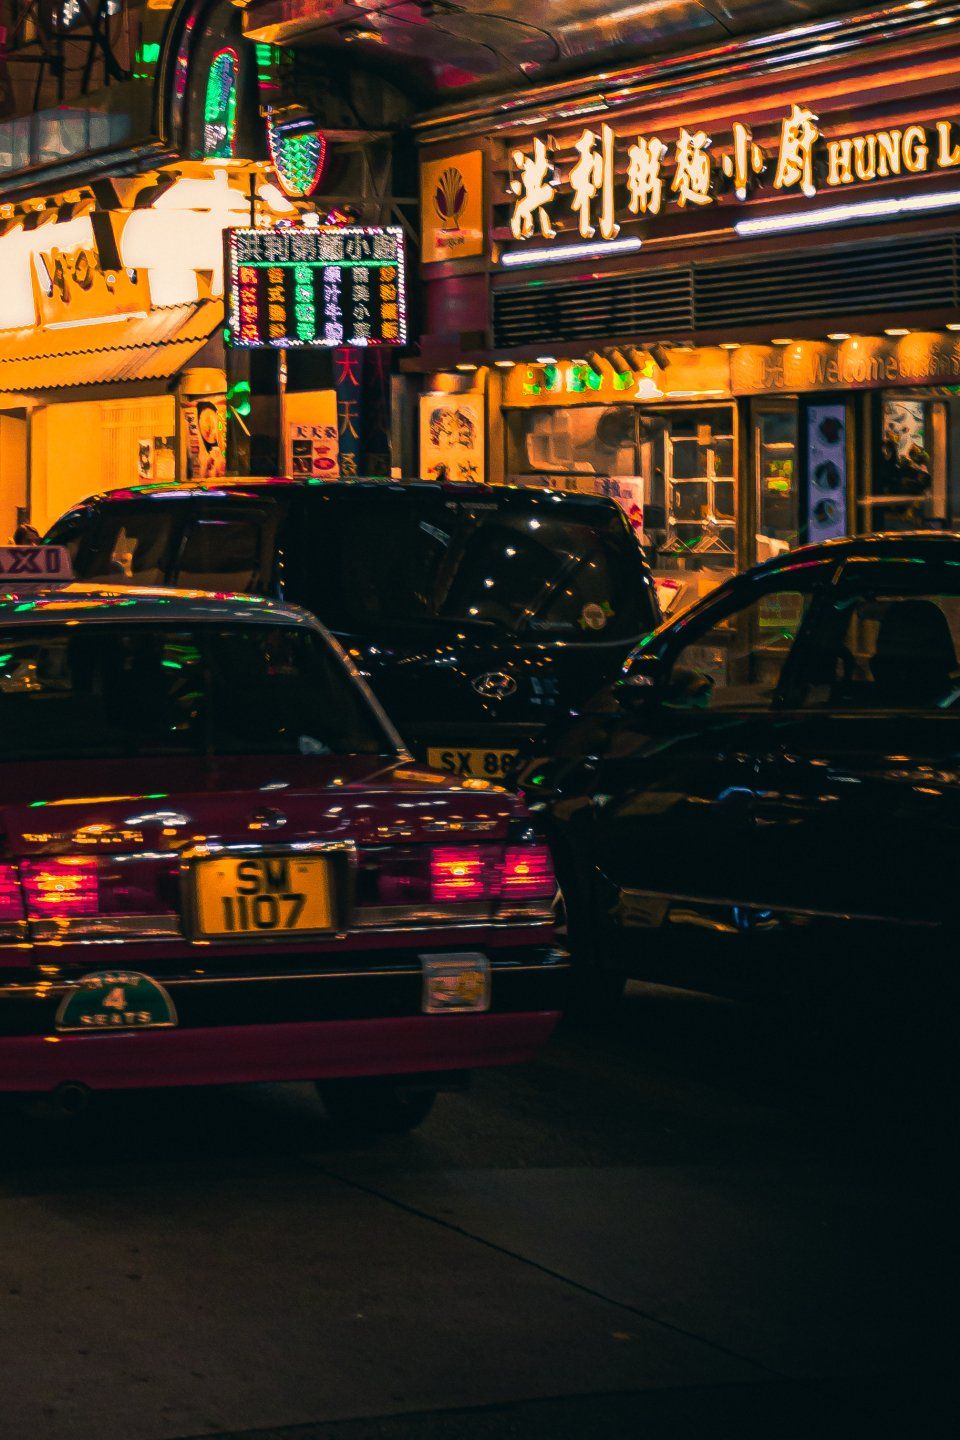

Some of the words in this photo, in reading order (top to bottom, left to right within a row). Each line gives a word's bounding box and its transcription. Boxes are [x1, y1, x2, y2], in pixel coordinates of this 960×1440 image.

[826, 125, 929, 186] HUNG
[442, 751, 473, 775] SX
[222, 894, 307, 932] 1107
[102, 987, 127, 1010] 4
